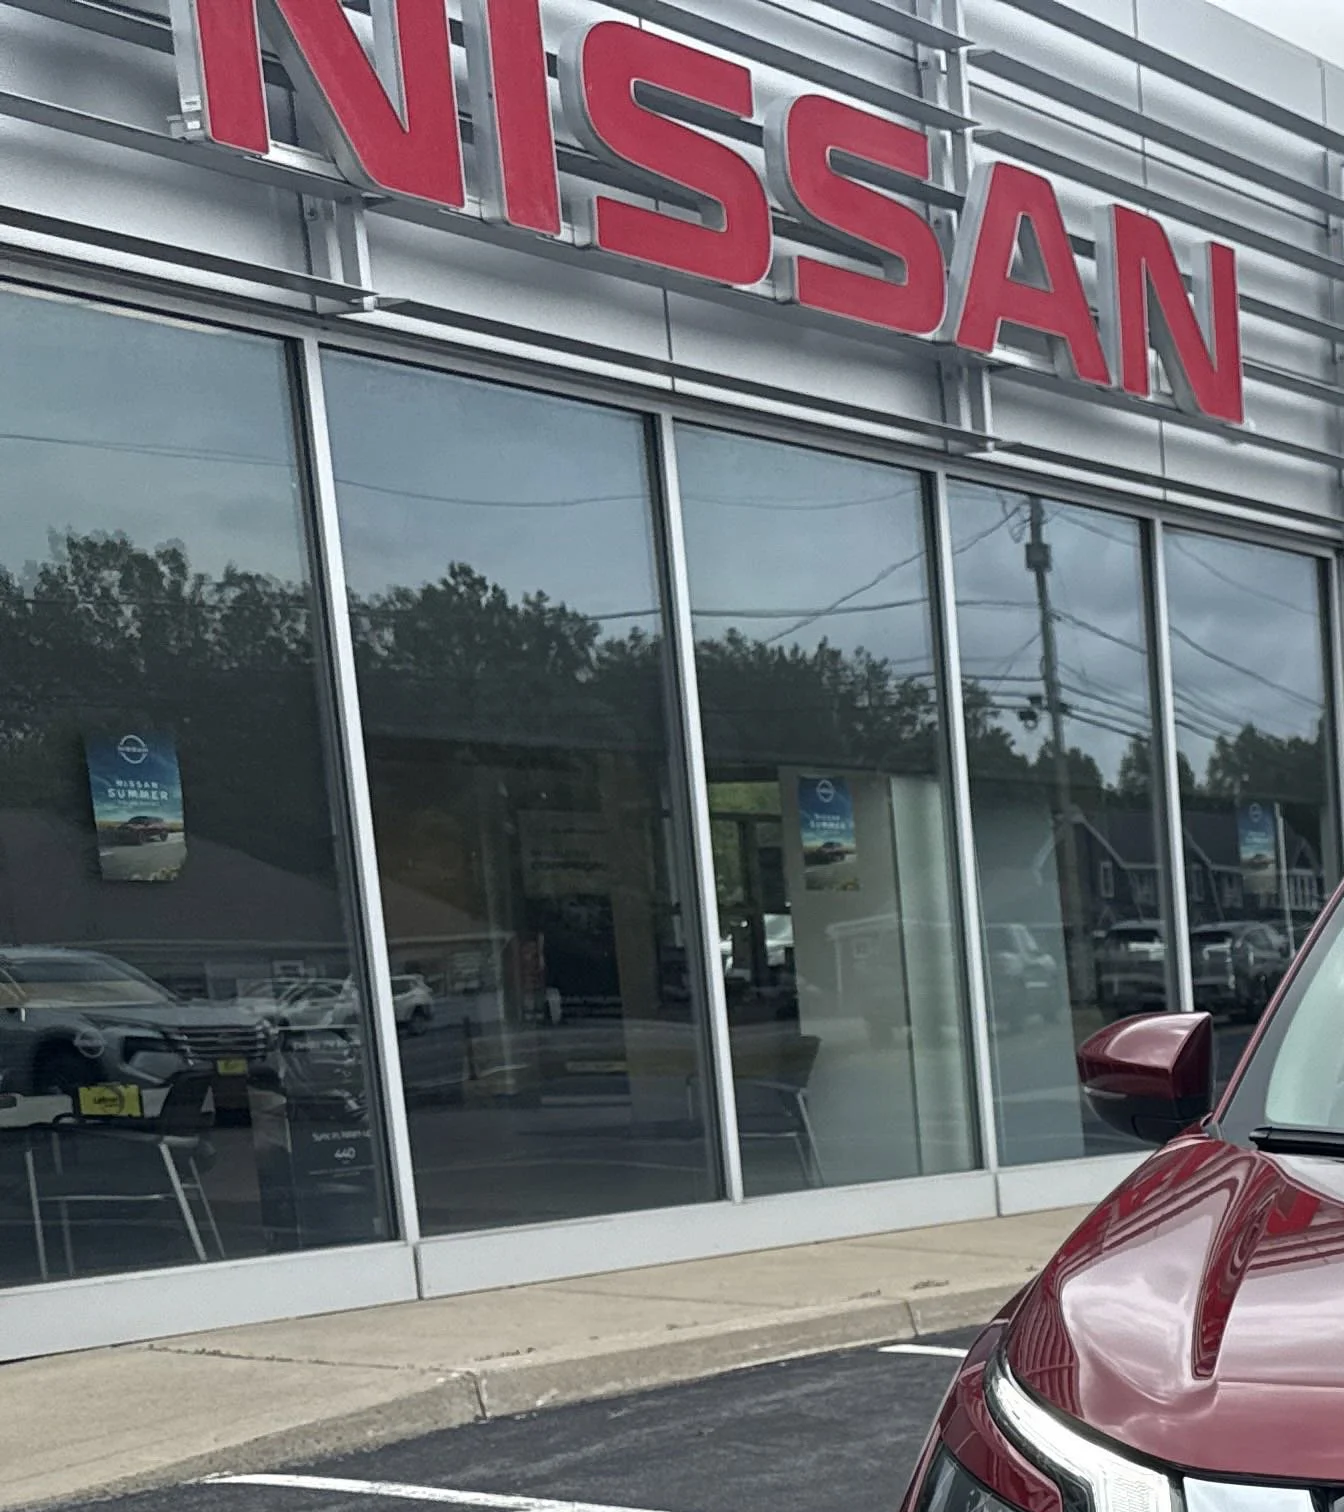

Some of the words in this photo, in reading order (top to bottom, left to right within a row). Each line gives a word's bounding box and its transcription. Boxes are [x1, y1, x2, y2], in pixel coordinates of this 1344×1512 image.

[180, 0, 1246, 425] NISSAN
[115, 779, 159, 789] NISSAN
[107, 788, 169, 801] SUMMER
